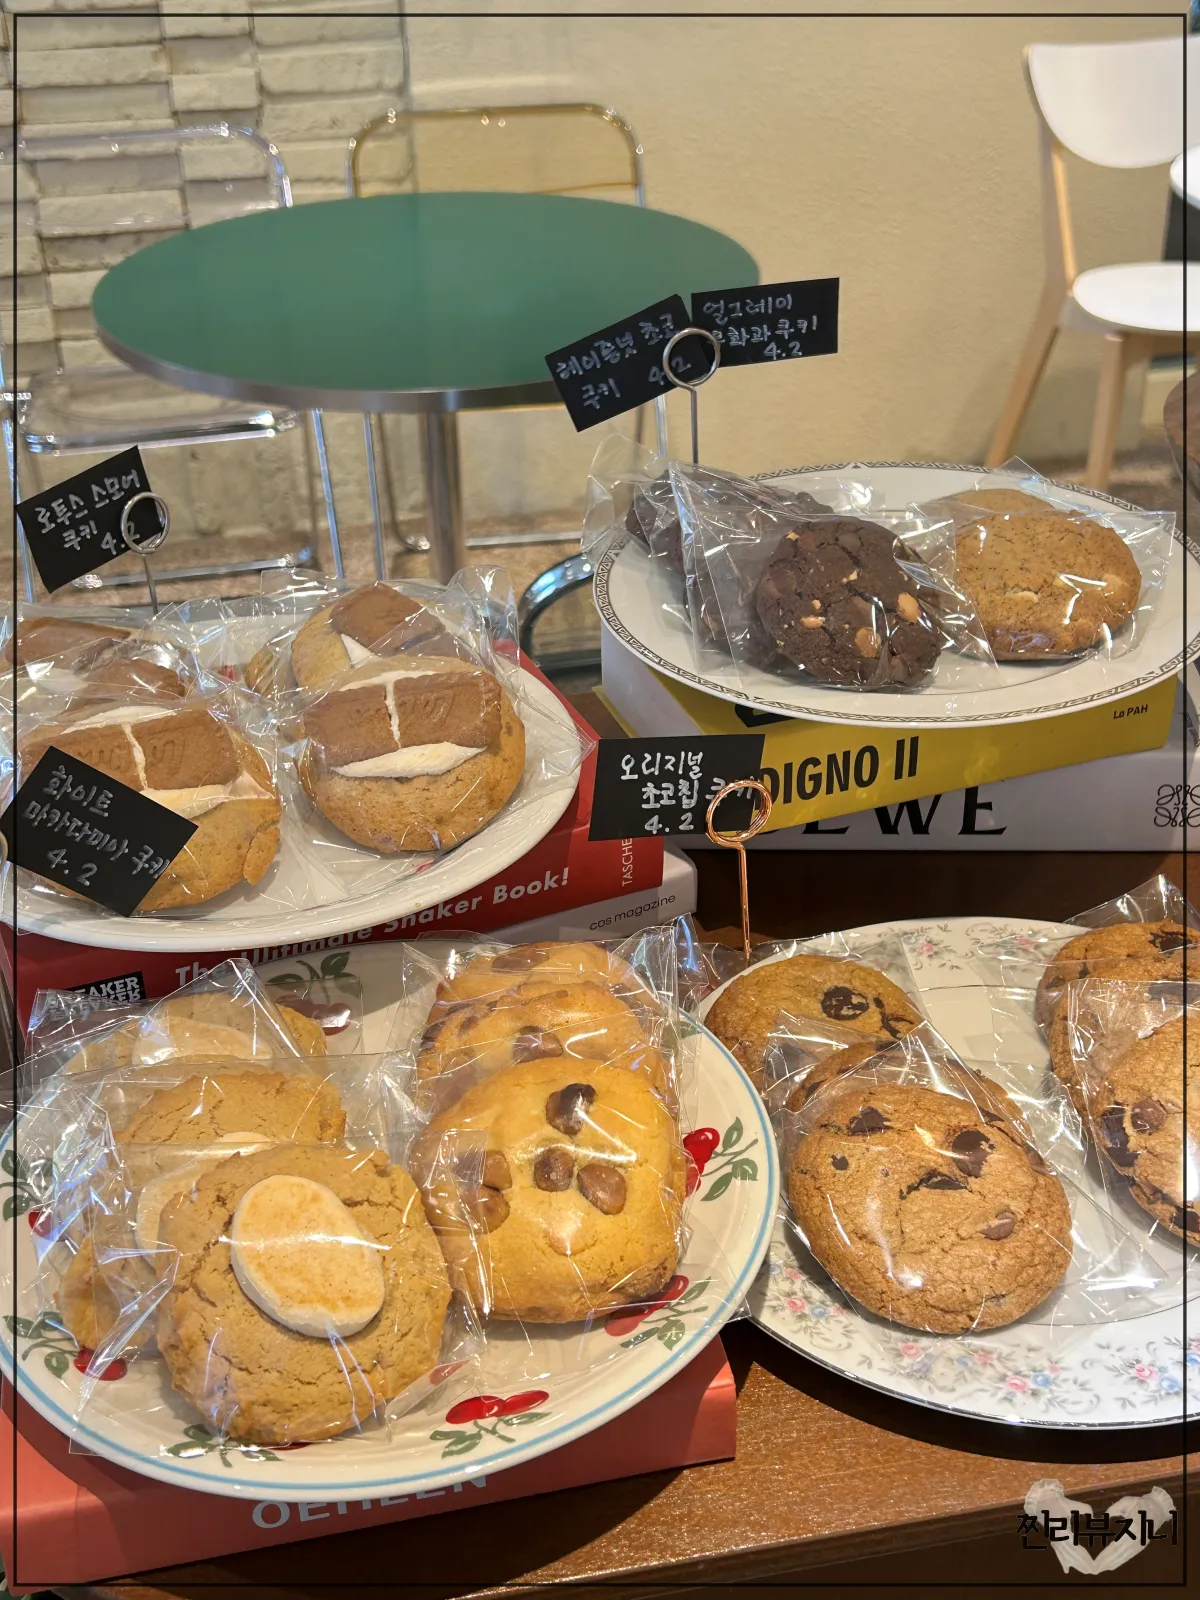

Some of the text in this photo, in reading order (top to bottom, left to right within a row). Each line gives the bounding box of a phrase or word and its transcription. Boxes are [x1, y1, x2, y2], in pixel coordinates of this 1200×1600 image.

[702, 293, 793, 326] 얼그레이
[774, 315, 818, 340] 쿠키
[763, 340, 803, 361] 4.2
[580, 377, 621, 410] 쿠키
[34, 468, 141, 534] 로투스 스모어
[62, 519, 98, 551] 쿠키
[1126, 703, 1149, 717] PAH
[620, 751, 704, 781] 오리지널
[42, 764, 114, 818] 화이트
[641, 778, 700, 810] 초코칩
[643, 811, 695, 835] 4.2
[22, 800, 171, 880] 마카다미아 쿠키
[46, 848, 98, 887] 4.2
[492, 866, 570, 905] Book!
[589, 894, 676, 931] cos magazine
